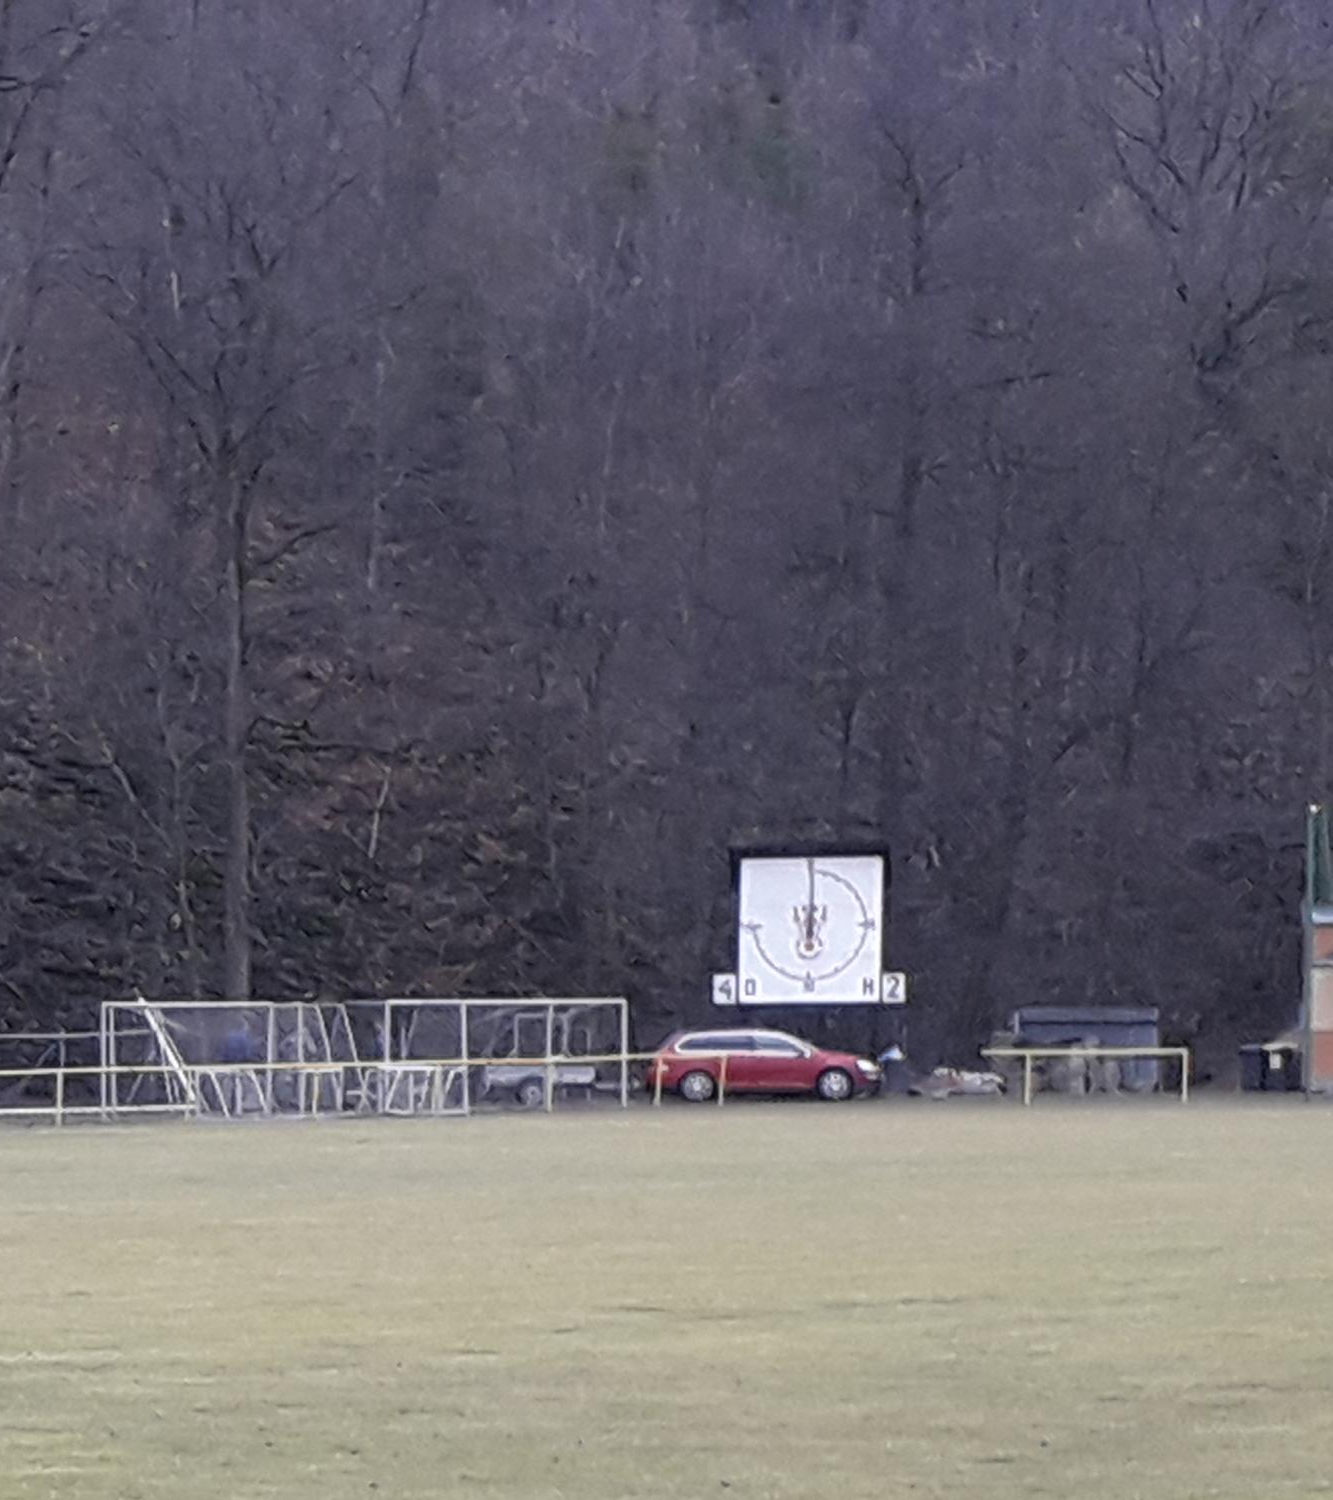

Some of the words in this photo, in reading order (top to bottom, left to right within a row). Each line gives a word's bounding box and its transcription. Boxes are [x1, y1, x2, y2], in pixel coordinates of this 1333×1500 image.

[718, 978, 733, 1000] 4
[862, 977, 875, 996] H
[886, 975, 901, 999] 2
